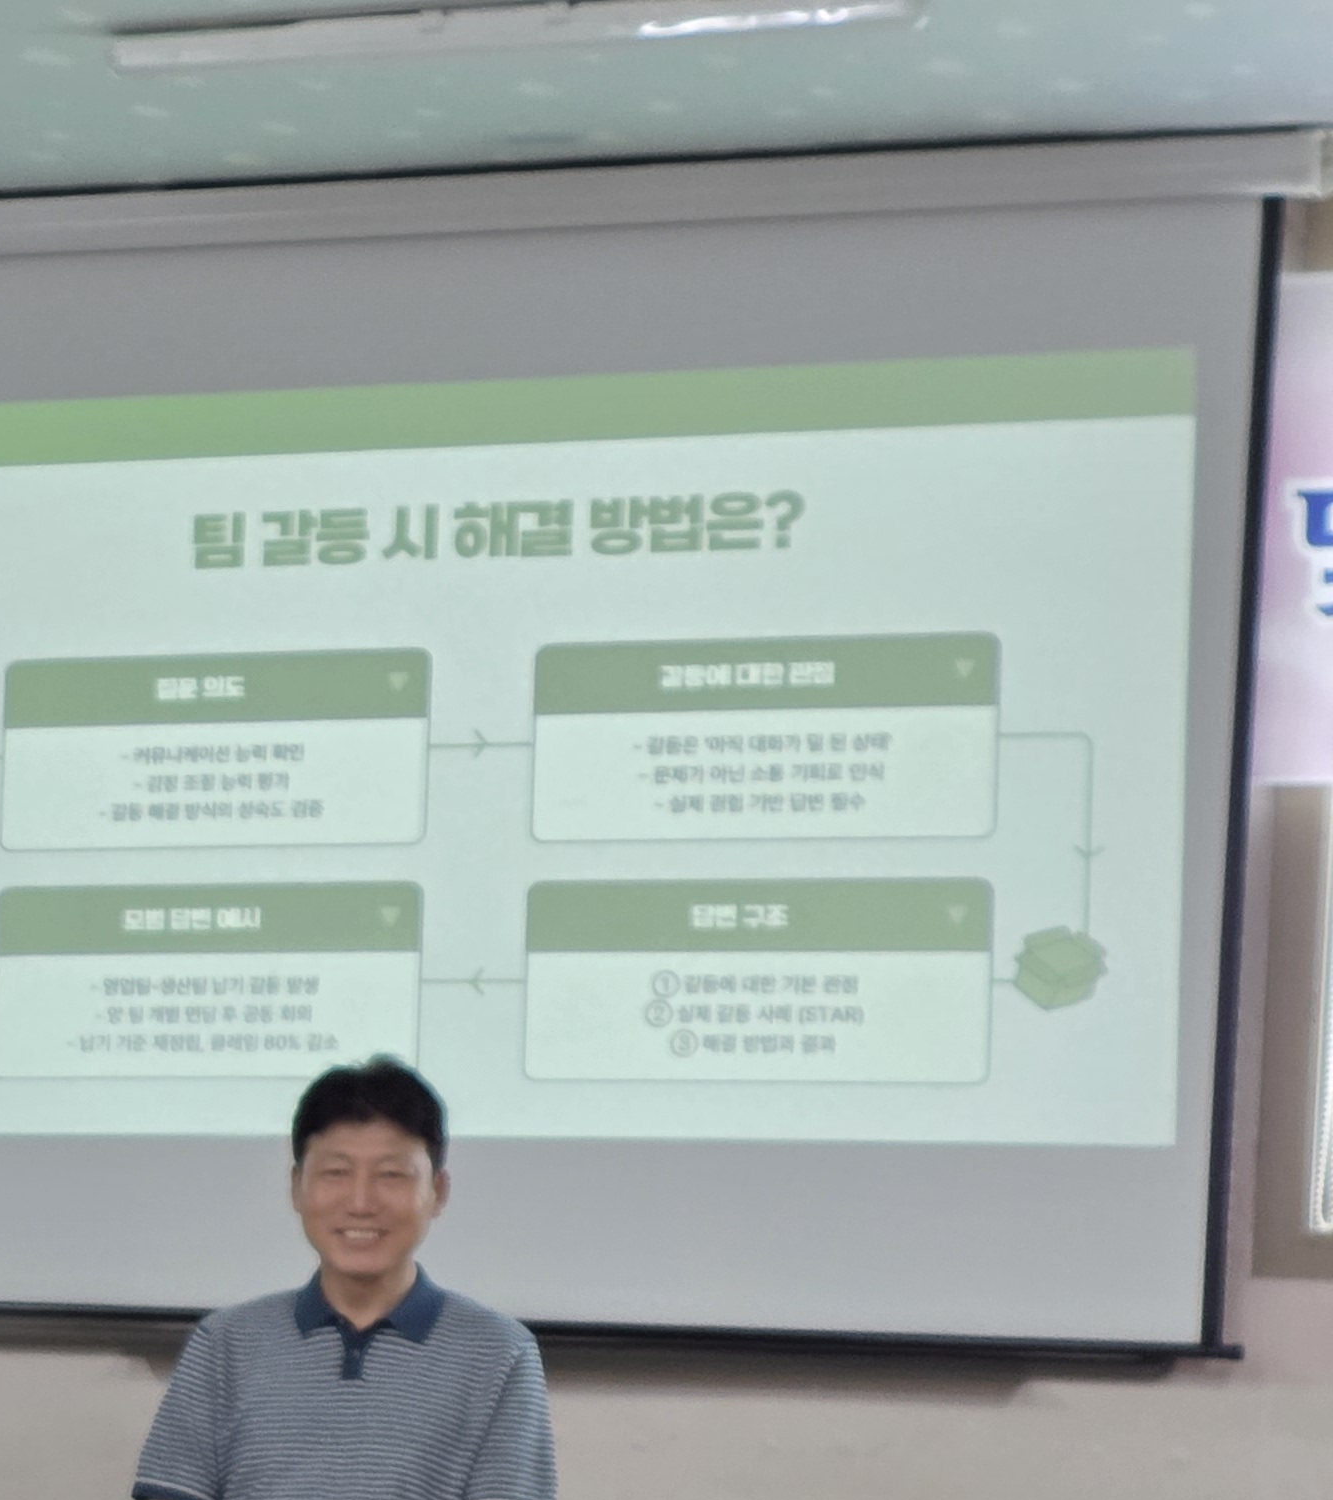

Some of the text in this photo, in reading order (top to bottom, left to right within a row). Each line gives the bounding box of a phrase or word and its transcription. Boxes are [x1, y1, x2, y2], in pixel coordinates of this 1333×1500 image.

[192, 490, 805, 569] 팀 갈등 시 해결 방법은?
